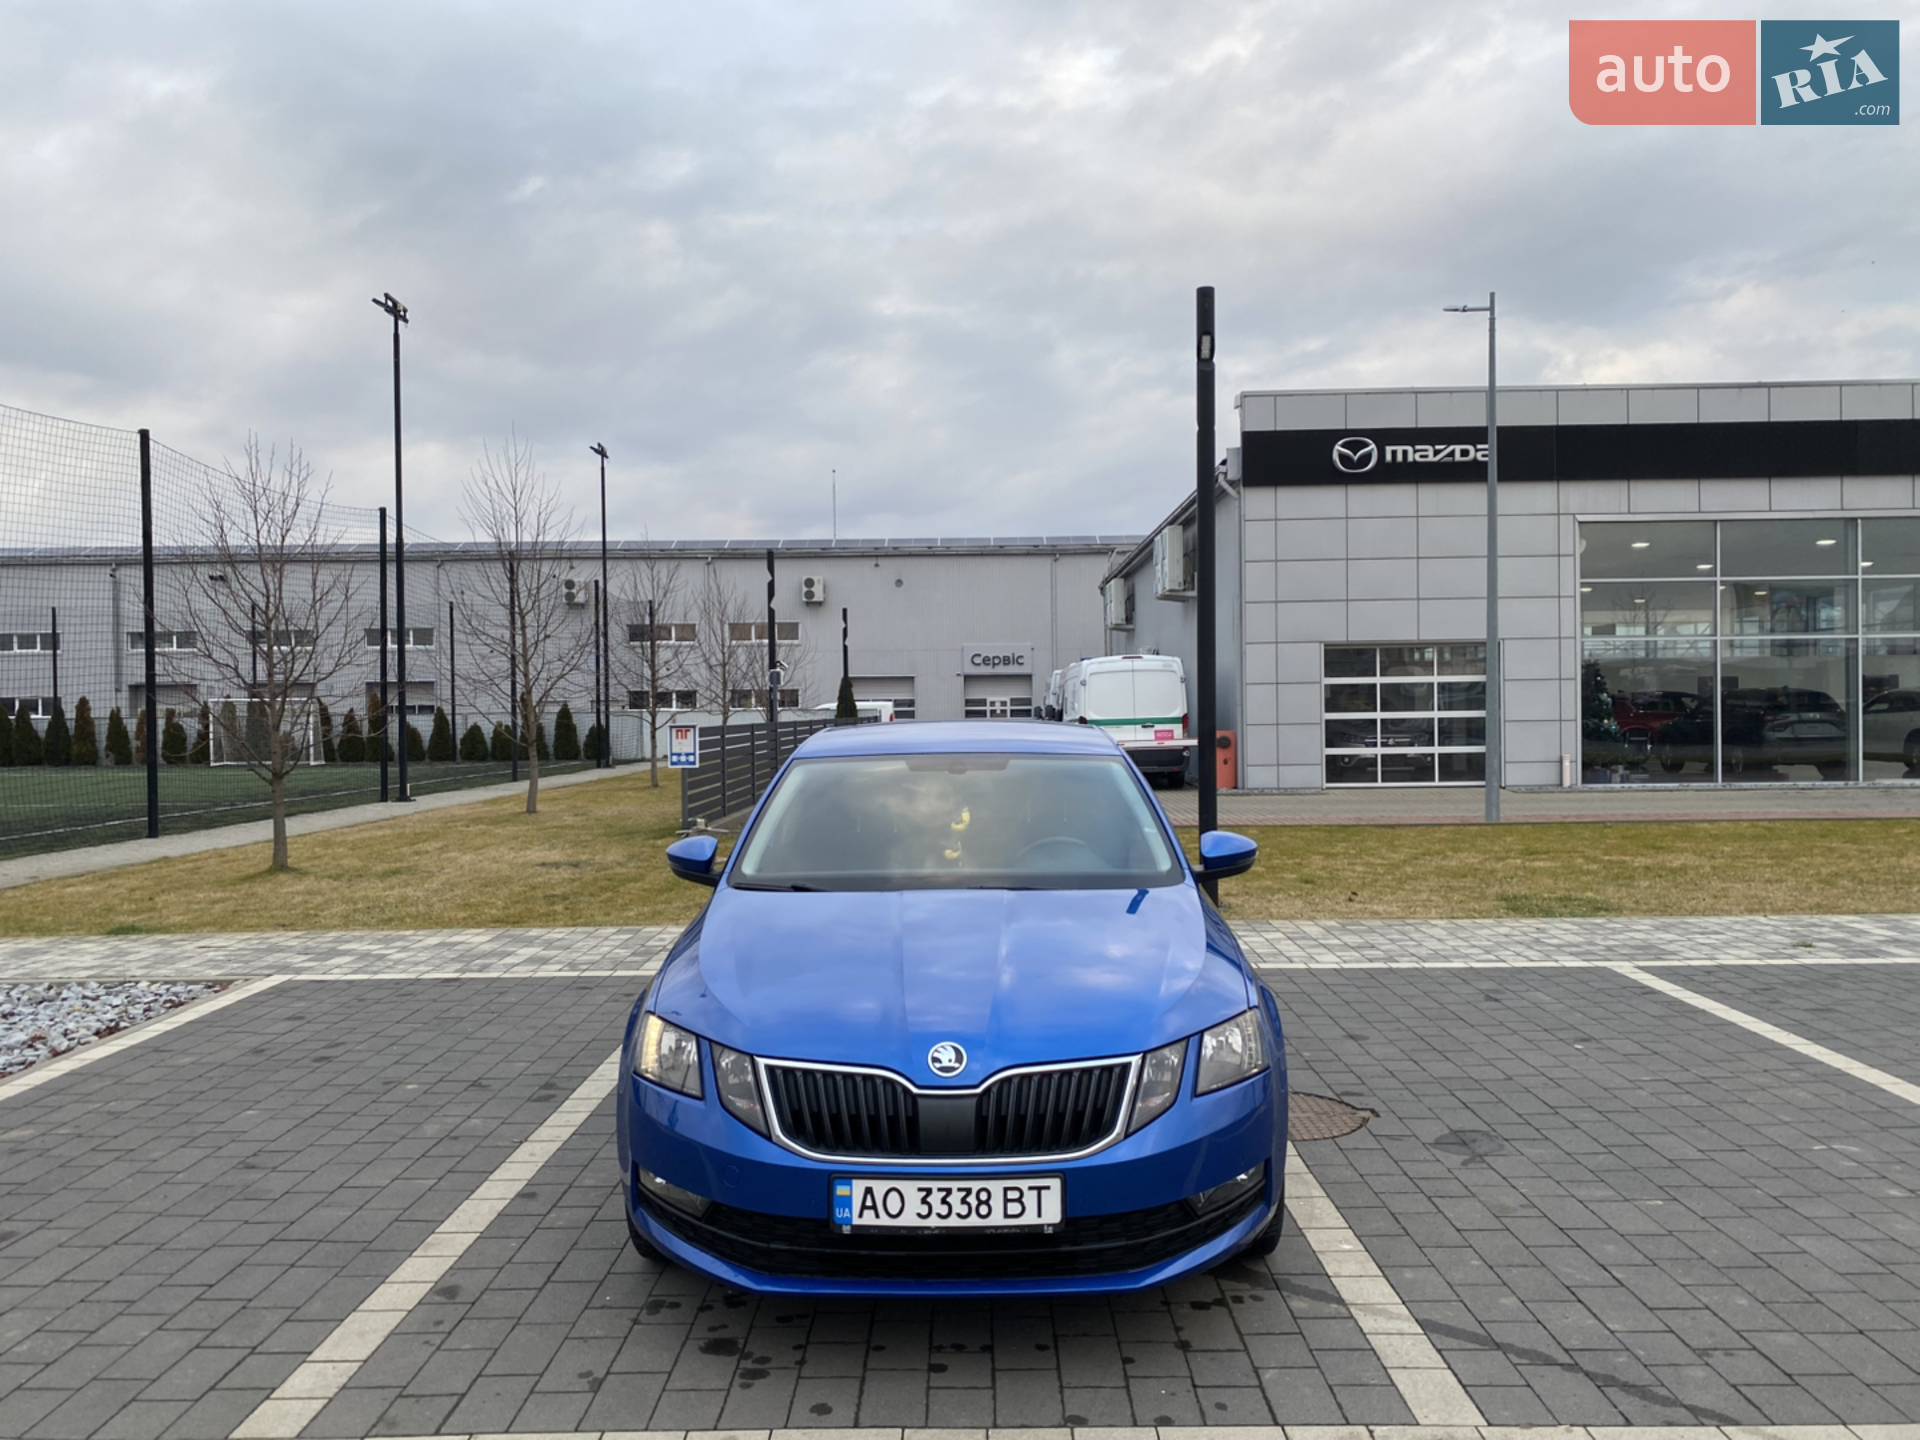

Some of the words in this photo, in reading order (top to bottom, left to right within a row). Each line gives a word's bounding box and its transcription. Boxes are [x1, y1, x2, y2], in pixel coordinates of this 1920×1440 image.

[970, 652, 1025, 669] Сервіс
[858, 1186, 906, 1220] AO
[916, 1186, 993, 1220] 3338
[1002, 1185, 1052, 1220] BT
[836, 1207, 852, 1219] UA
